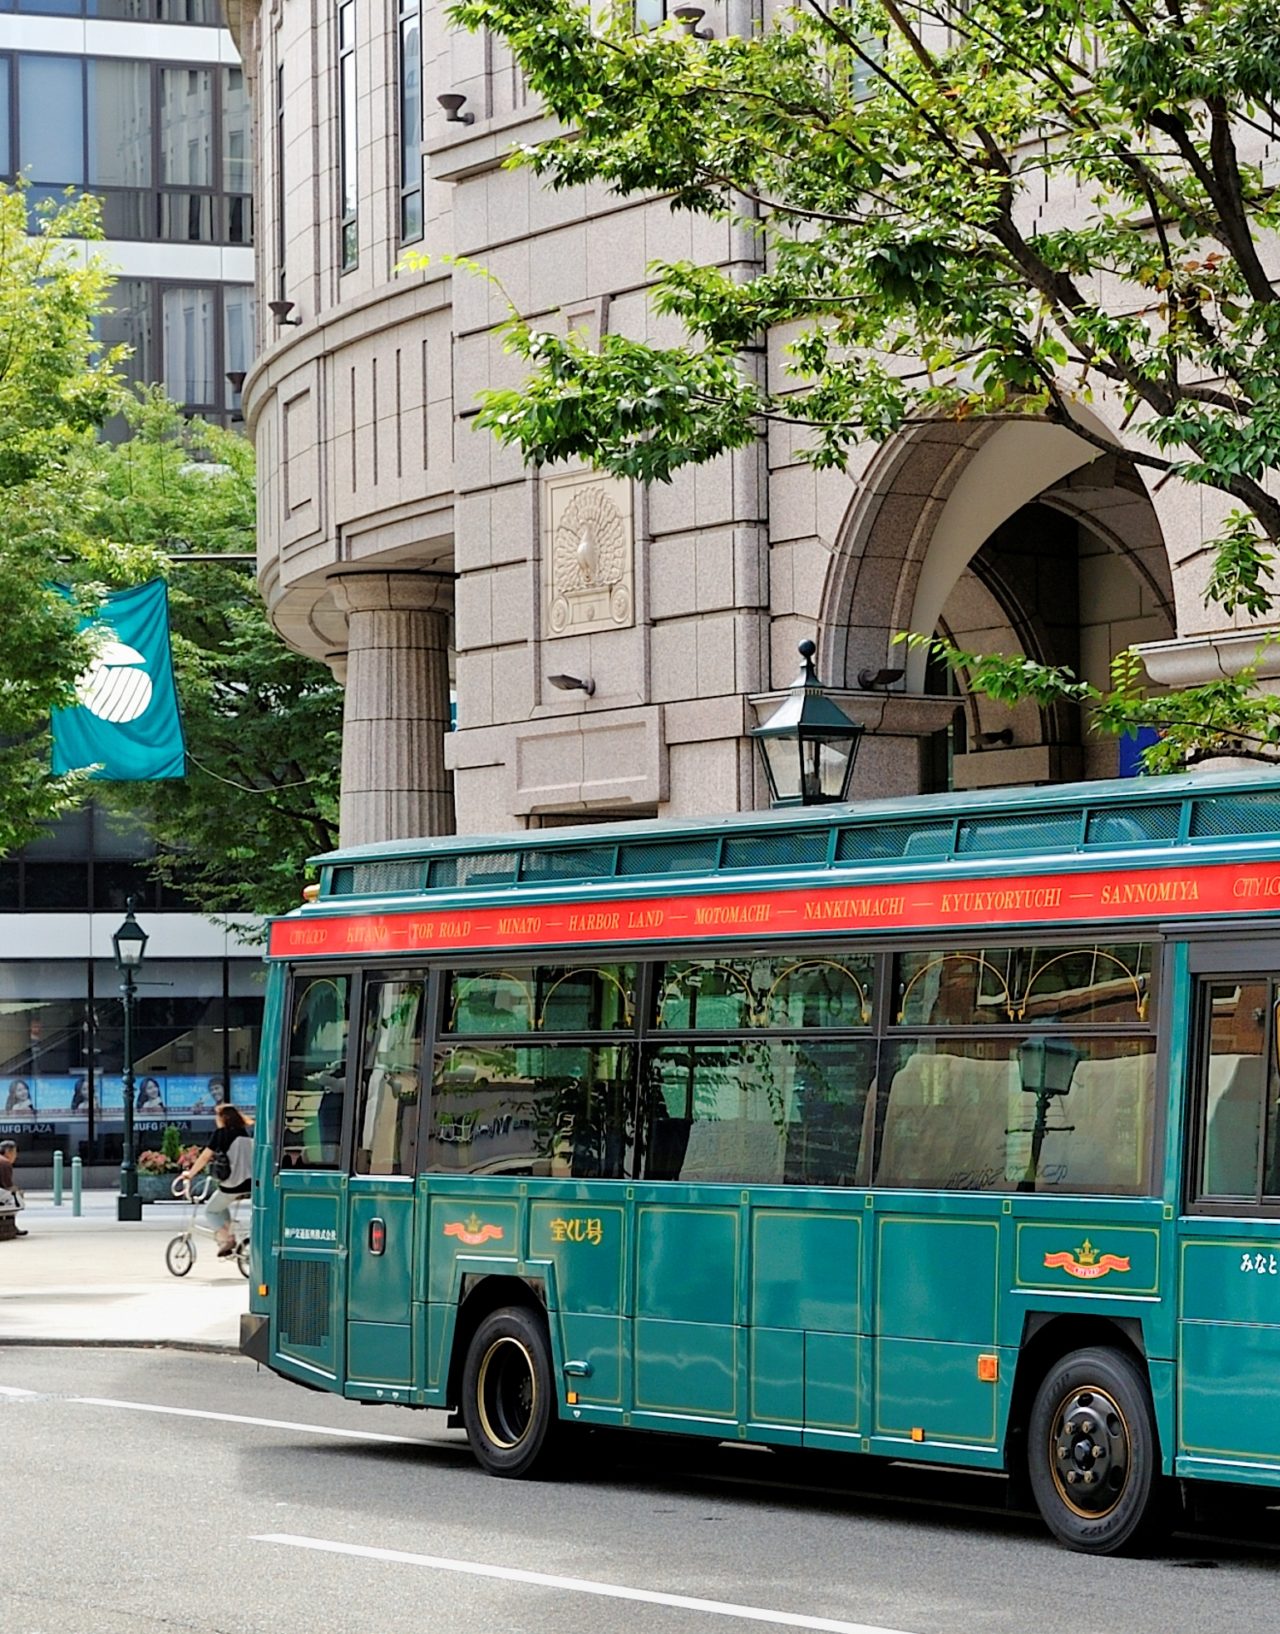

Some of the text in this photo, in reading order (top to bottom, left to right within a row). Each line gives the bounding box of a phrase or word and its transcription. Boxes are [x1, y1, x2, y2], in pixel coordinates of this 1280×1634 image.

[347, 926, 388, 943] KITANO
[411, 923, 433, 940] TOR
[439, 921, 471, 938] ROAD
[497, 916, 542, 935] MINATO
[568, 912, 620, 932] HARBOR
[628, 910, 664, 928] LAND
[693, 904, 772, 925] MOTOMACHI
[803, 896, 905, 920] NANKINMACHI
[940, 887, 1062, 913] KYUKYORYUCHI
[1100, 880, 1199, 905] SANNOMIYA
[1232, 876, 1262, 897] CITY
[0, 1123, 52, 1134] UFG PLAZA
[550, 1217, 603, 1245] 宝くじ号
[1240, 1253, 1278, 1275] みなと
